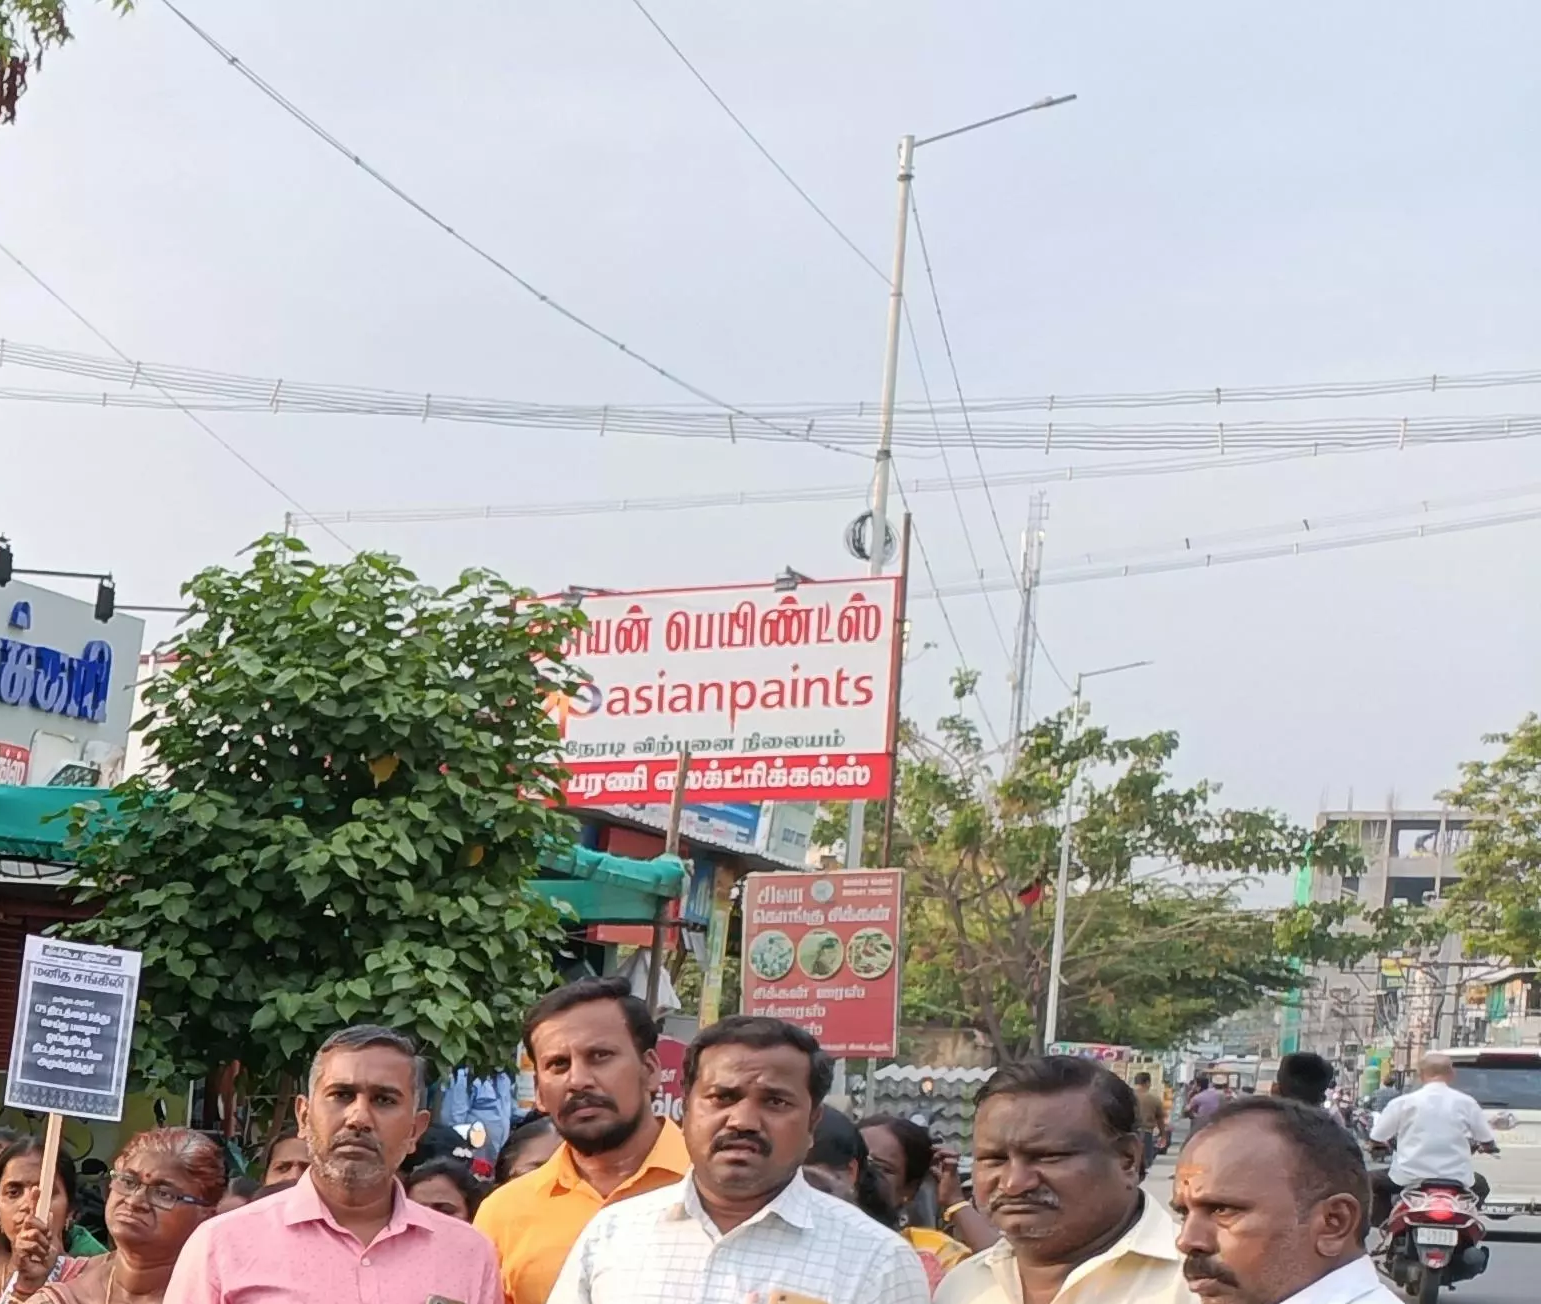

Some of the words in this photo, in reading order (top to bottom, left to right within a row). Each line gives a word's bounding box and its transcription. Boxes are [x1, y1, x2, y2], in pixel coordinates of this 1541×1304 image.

[665, 591, 882, 652] பெயிண்ட்ஸ்
[607, 663, 874, 733] asianpaints
[33, 967, 70, 983] மனித
[74, 971, 124, 988] சங்கிலி
